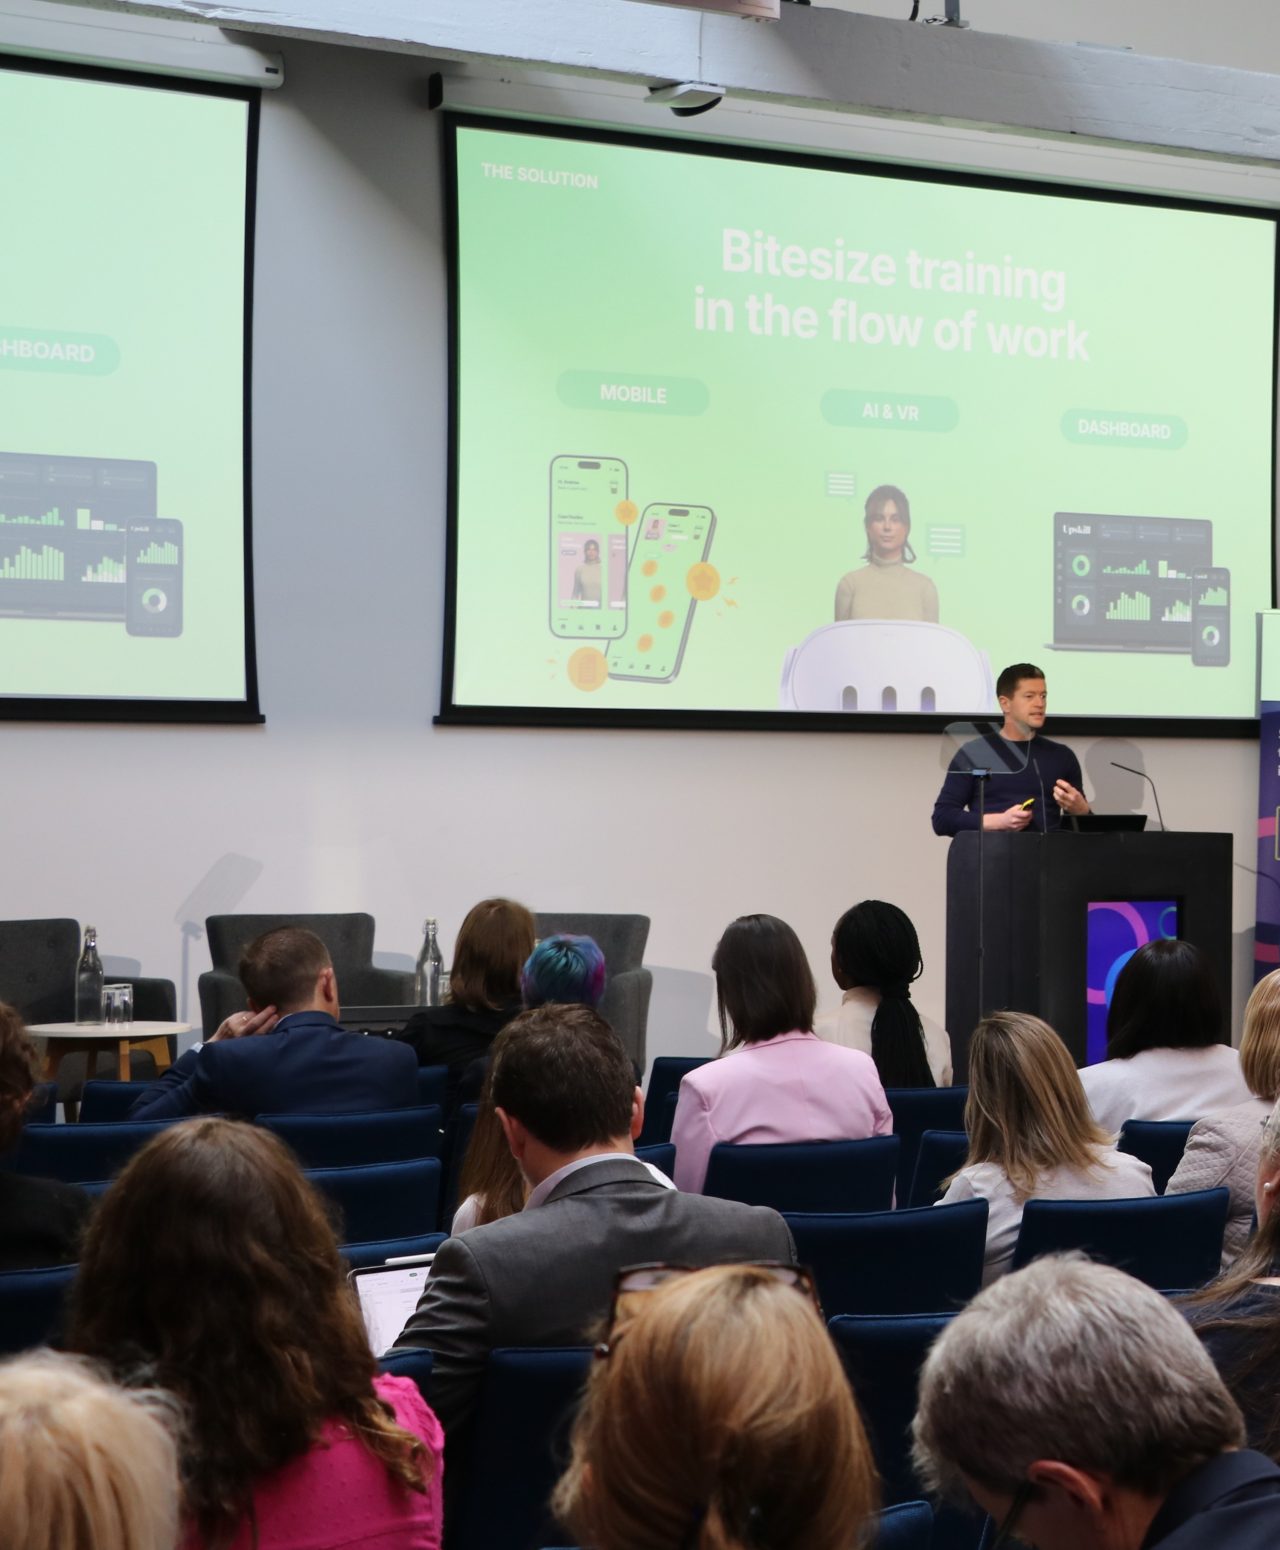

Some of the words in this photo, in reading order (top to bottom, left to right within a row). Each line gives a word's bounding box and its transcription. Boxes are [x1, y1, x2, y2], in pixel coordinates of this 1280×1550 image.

[481, 162, 513, 180] THE
[518, 167, 598, 188] SOLUTION
[722, 228, 897, 285] Bitesize
[906, 249, 1067, 312] training
[694, 285, 735, 332] in
[745, 293, 819, 339] the
[828, 297, 924, 347] flow
[933, 308, 978, 351] of
[986, 320, 1091, 362] work
[0, 339, 95, 362] HBOARD
[600, 383, 667, 404] MOBILE
[862, 402, 879, 418] AI
[883, 404, 893, 419] &
[897, 405, 919, 421] VR
[1079, 419, 1170, 439] DASHBOARD
